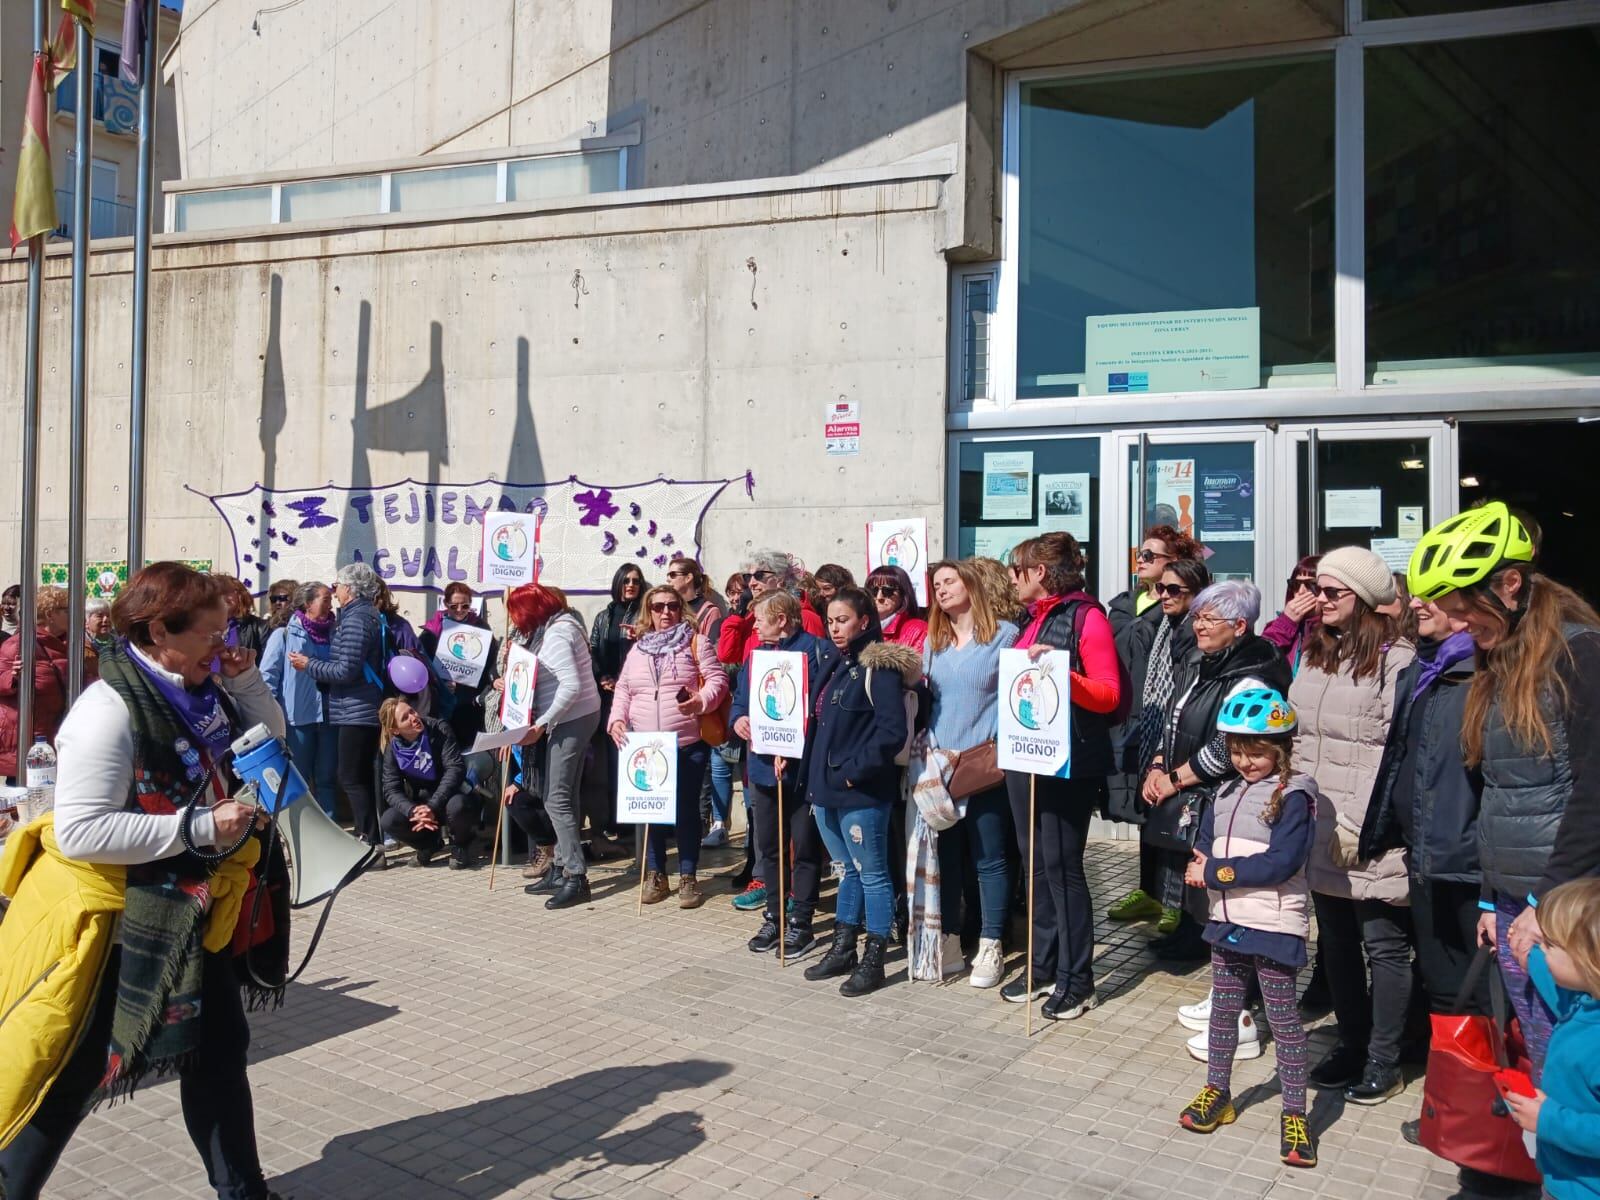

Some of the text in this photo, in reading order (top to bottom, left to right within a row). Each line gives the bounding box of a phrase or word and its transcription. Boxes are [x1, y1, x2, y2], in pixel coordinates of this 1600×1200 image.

[1172, 461, 1193, 478] 14
[762, 731, 795, 743] ¡DIGNO!
[1030, 737, 1060, 746] CONVENIO
[1012, 742, 1056, 758] ¡DIGNO!
[628, 801, 666, 811] ¡DIGNO!
